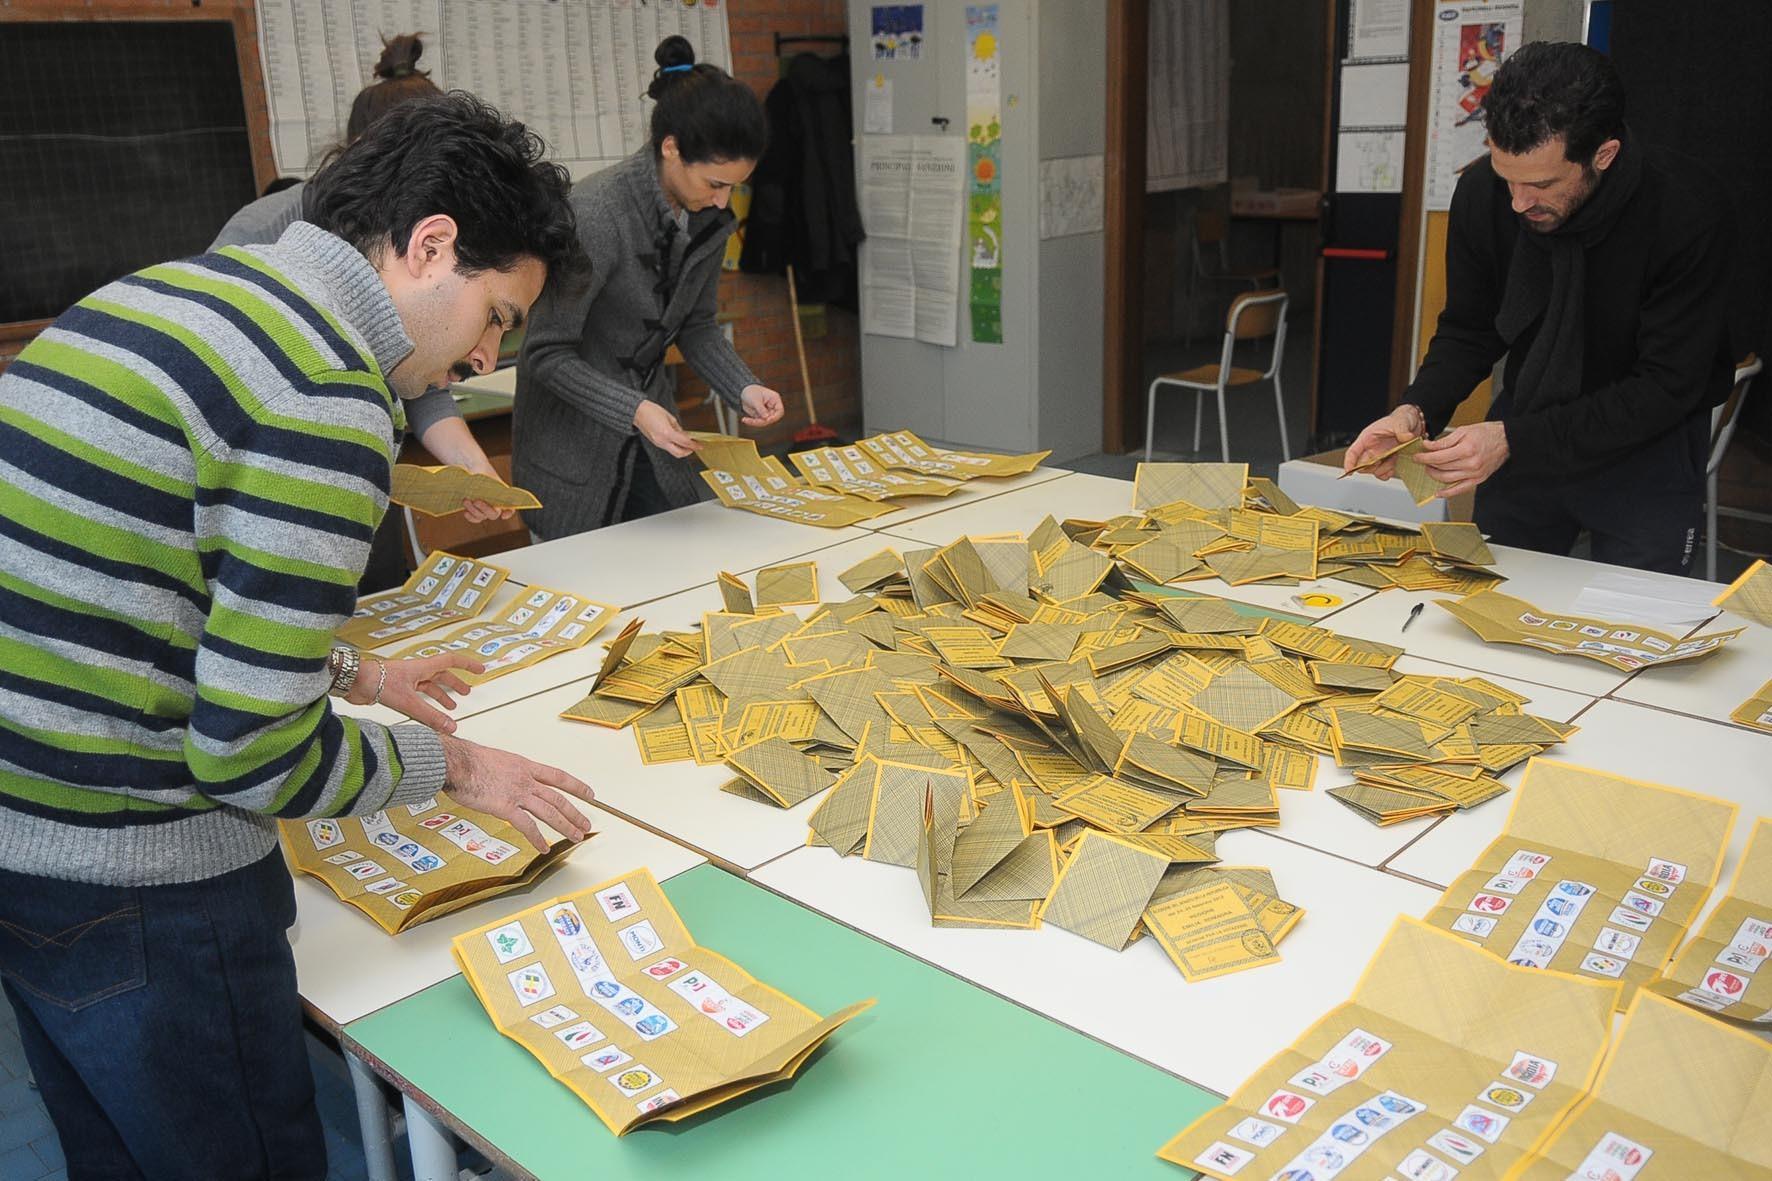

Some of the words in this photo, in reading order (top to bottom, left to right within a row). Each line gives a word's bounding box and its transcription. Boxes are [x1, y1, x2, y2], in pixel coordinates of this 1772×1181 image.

[609, 895, 626, 912] FN
[630, 930, 646, 953] MONTI
[1215, 1151, 1235, 1166] FN
